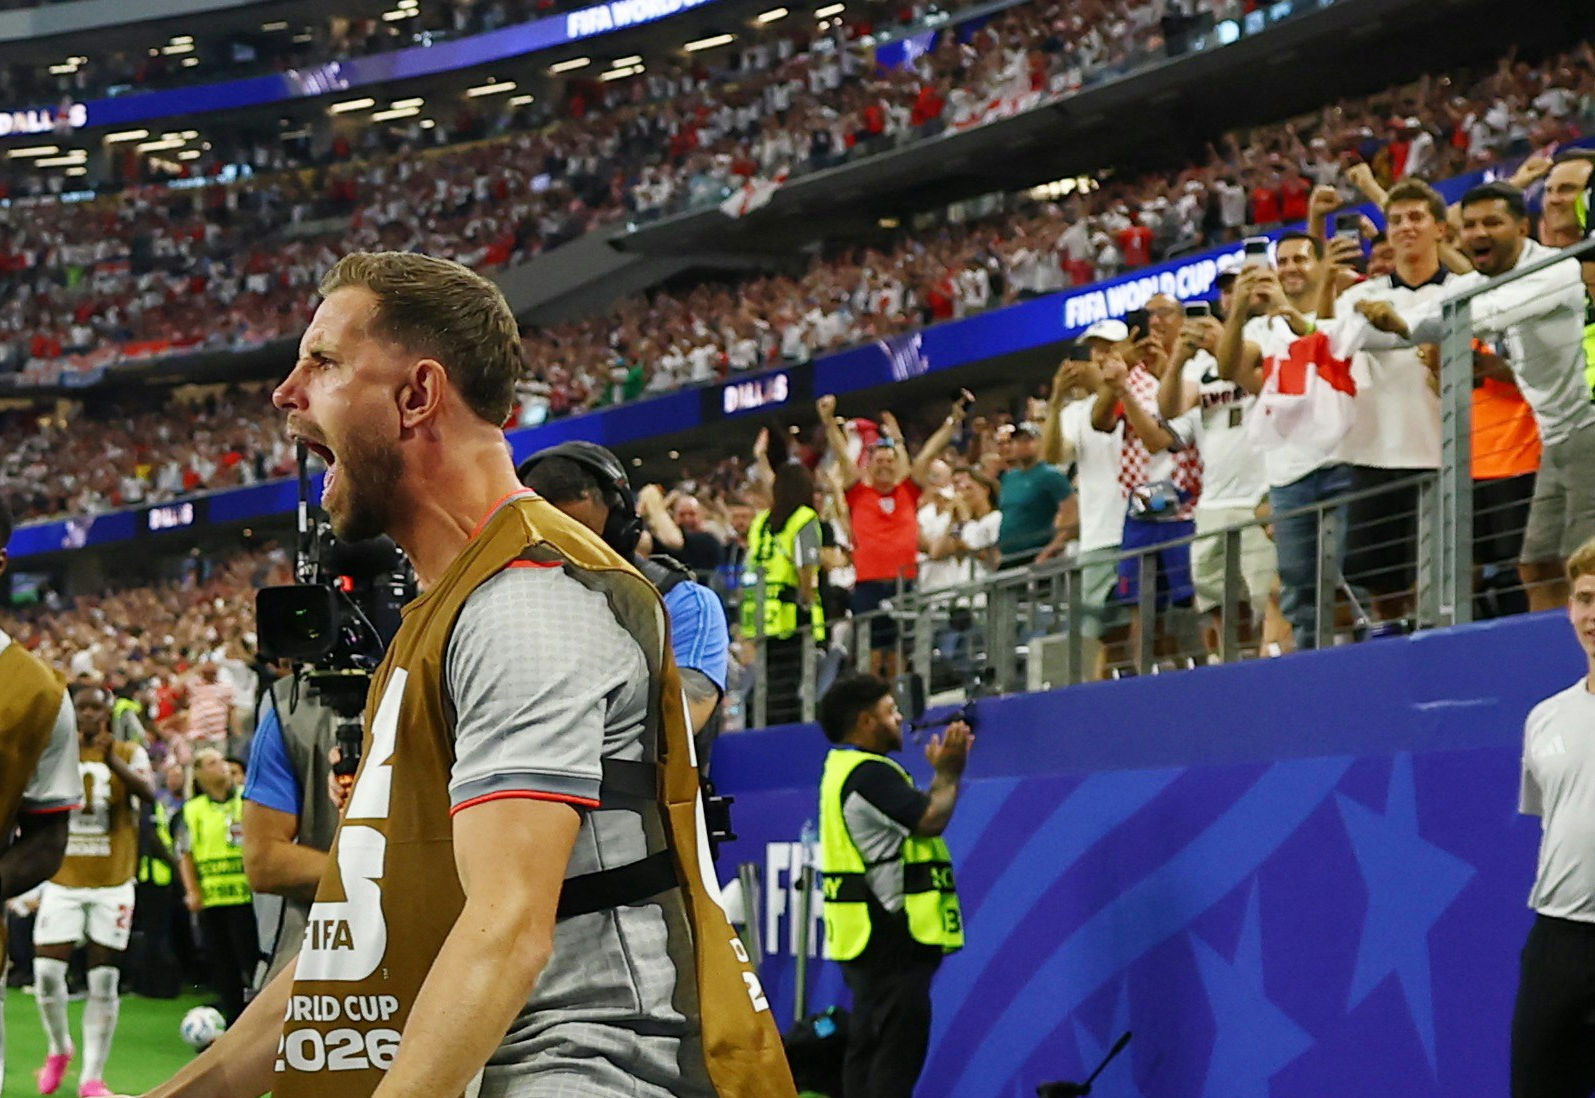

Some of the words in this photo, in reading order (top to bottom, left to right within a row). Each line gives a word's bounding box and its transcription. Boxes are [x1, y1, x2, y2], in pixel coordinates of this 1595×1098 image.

[1176, 259, 1217, 299] CUP
[284, 995, 341, 1021] RLD
[343, 995, 399, 1021] CUP
